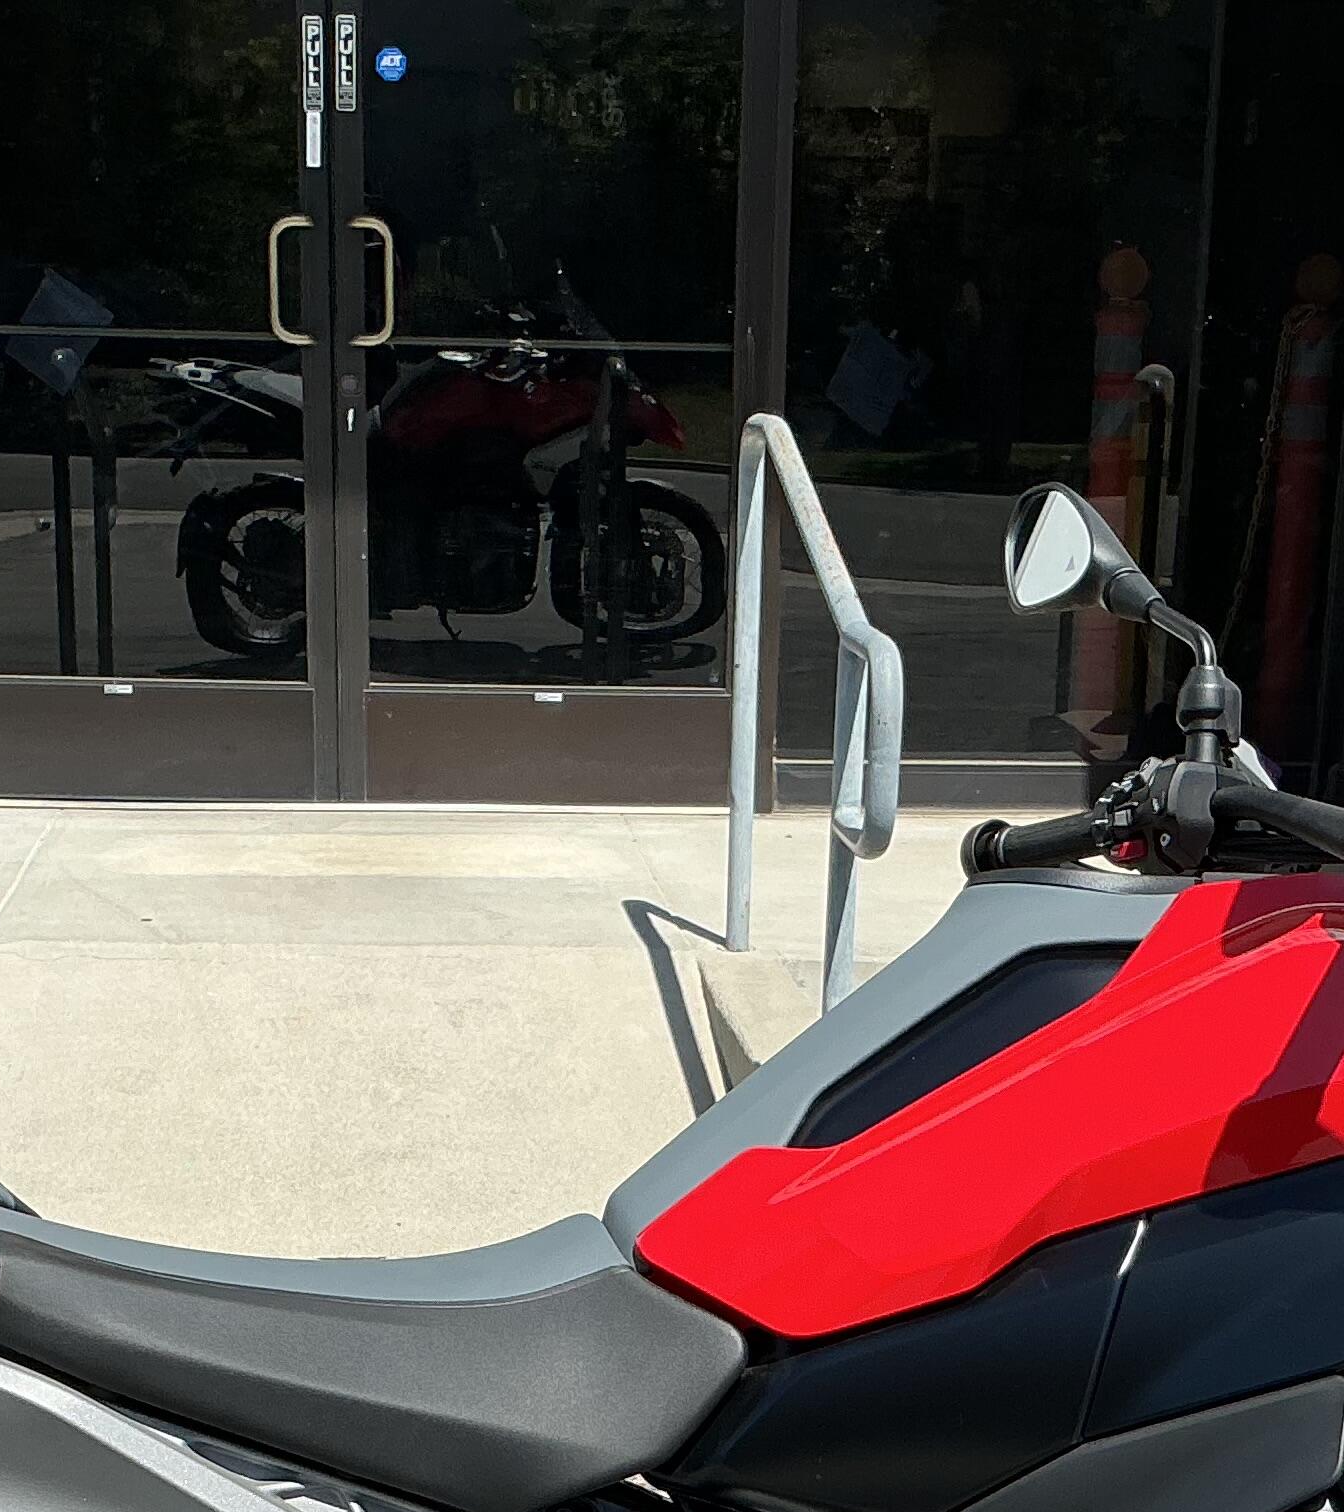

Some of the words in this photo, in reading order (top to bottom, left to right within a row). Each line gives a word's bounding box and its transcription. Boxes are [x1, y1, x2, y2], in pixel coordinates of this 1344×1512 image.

[306, 24, 320, 87] PULL
[340, 24, 353, 86] PULL
[380, 55, 401, 67] ADT
